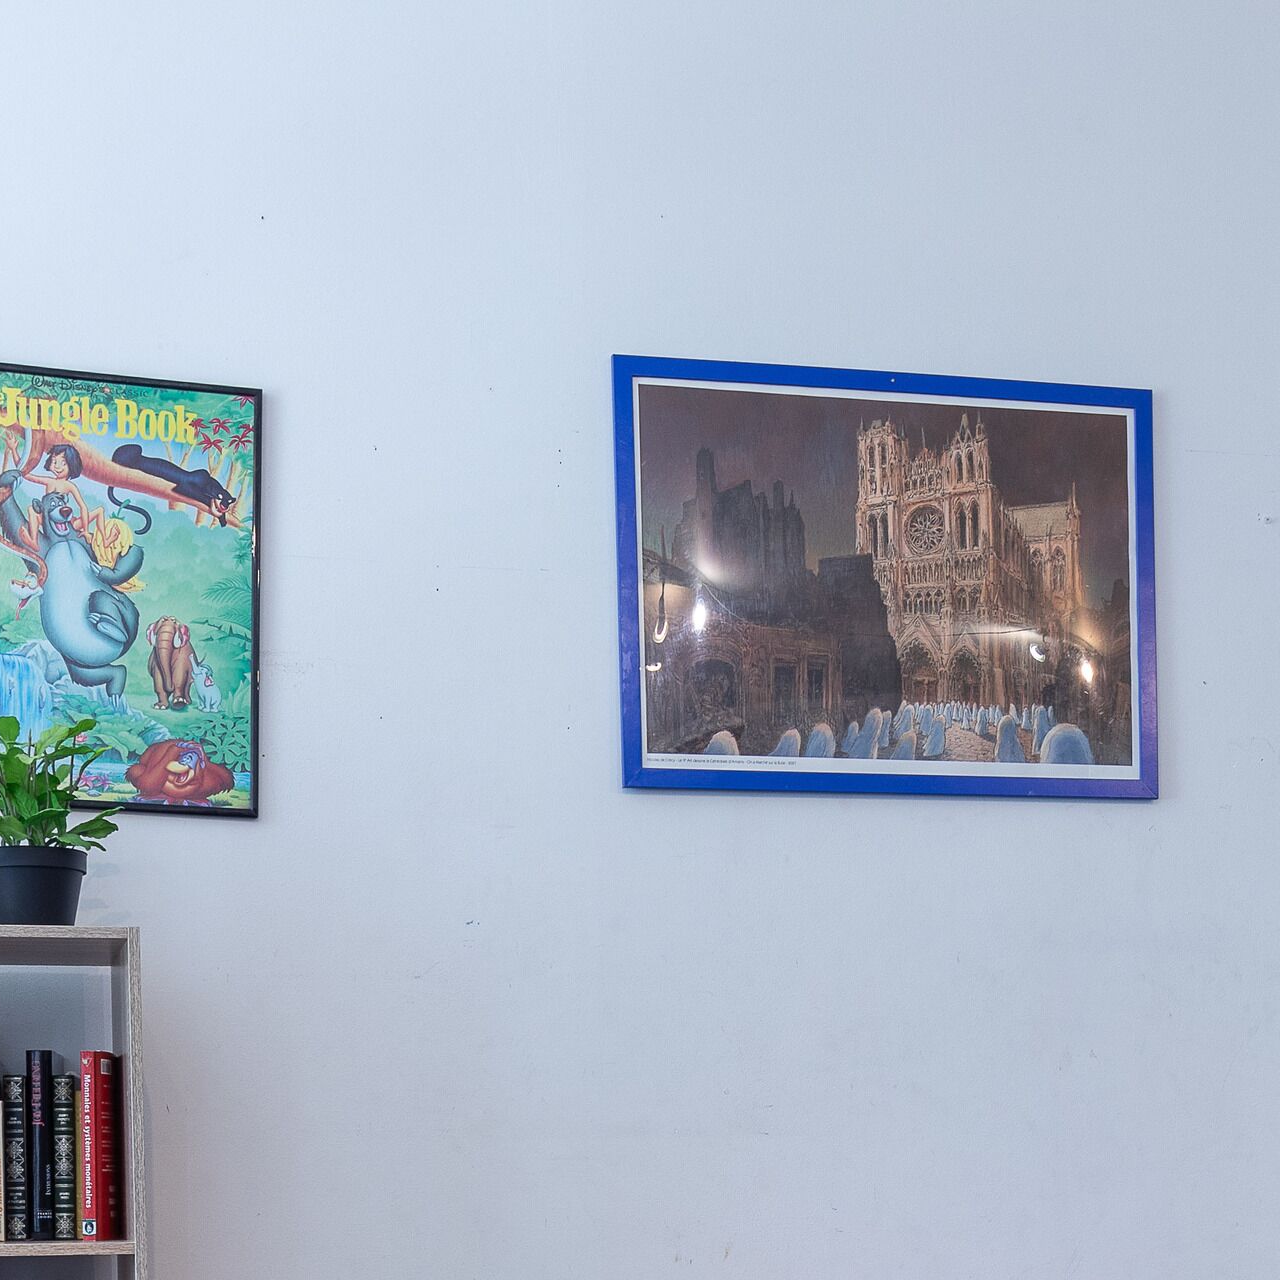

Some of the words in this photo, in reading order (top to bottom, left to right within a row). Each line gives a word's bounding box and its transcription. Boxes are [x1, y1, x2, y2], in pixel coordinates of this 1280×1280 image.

[115, 399, 199, 444] Book
[84, 1126, 92, 1161] systèmes
[85, 1163, 93, 1208] monétaires
